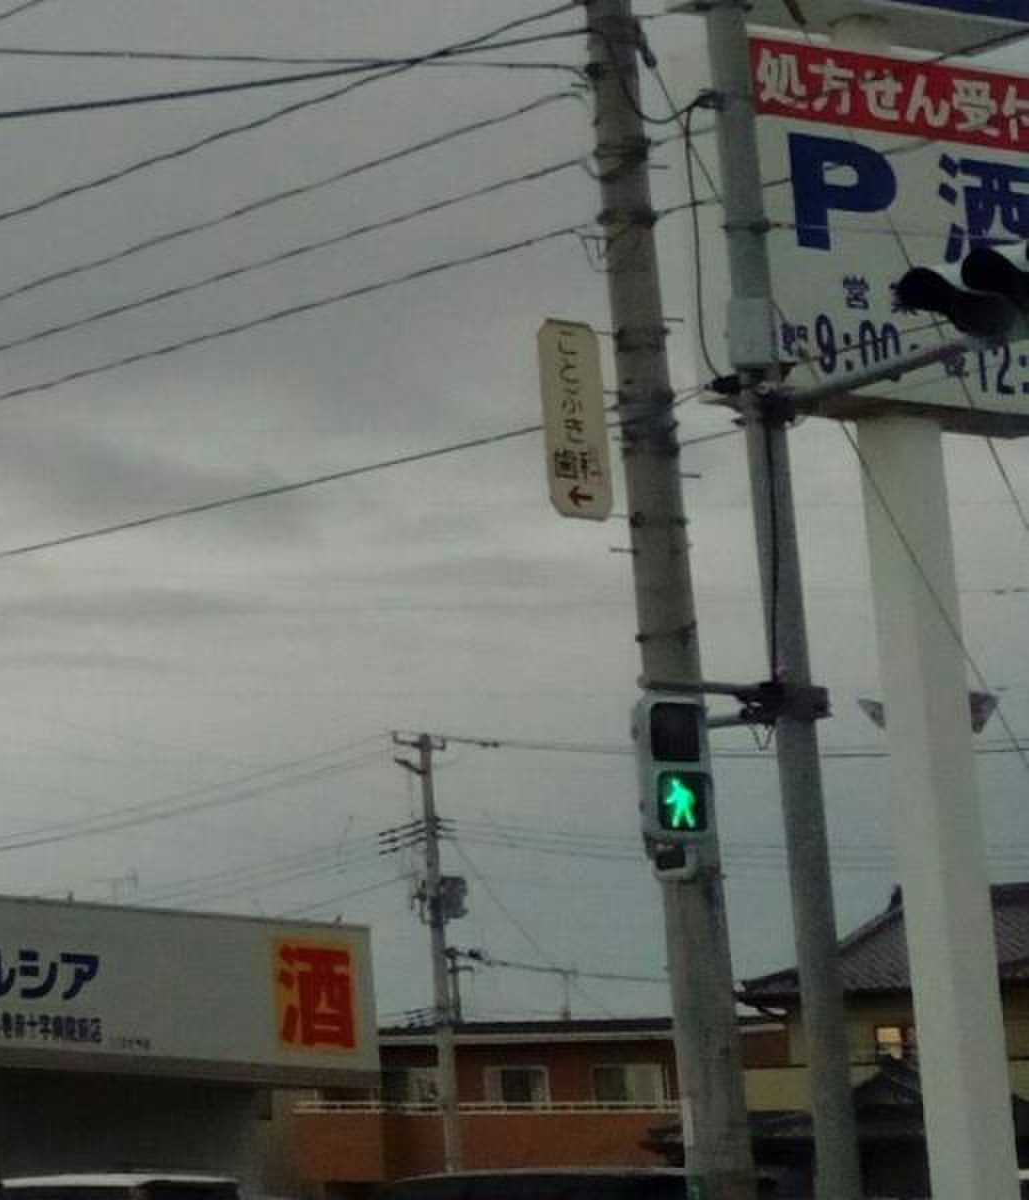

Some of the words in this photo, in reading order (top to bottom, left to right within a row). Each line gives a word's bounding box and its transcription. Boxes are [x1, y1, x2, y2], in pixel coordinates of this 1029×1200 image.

[757, 49, 1029, 142] 処方せん受付
[788, 133, 897, 251] P
[278, 943, 357, 1049] 酒
